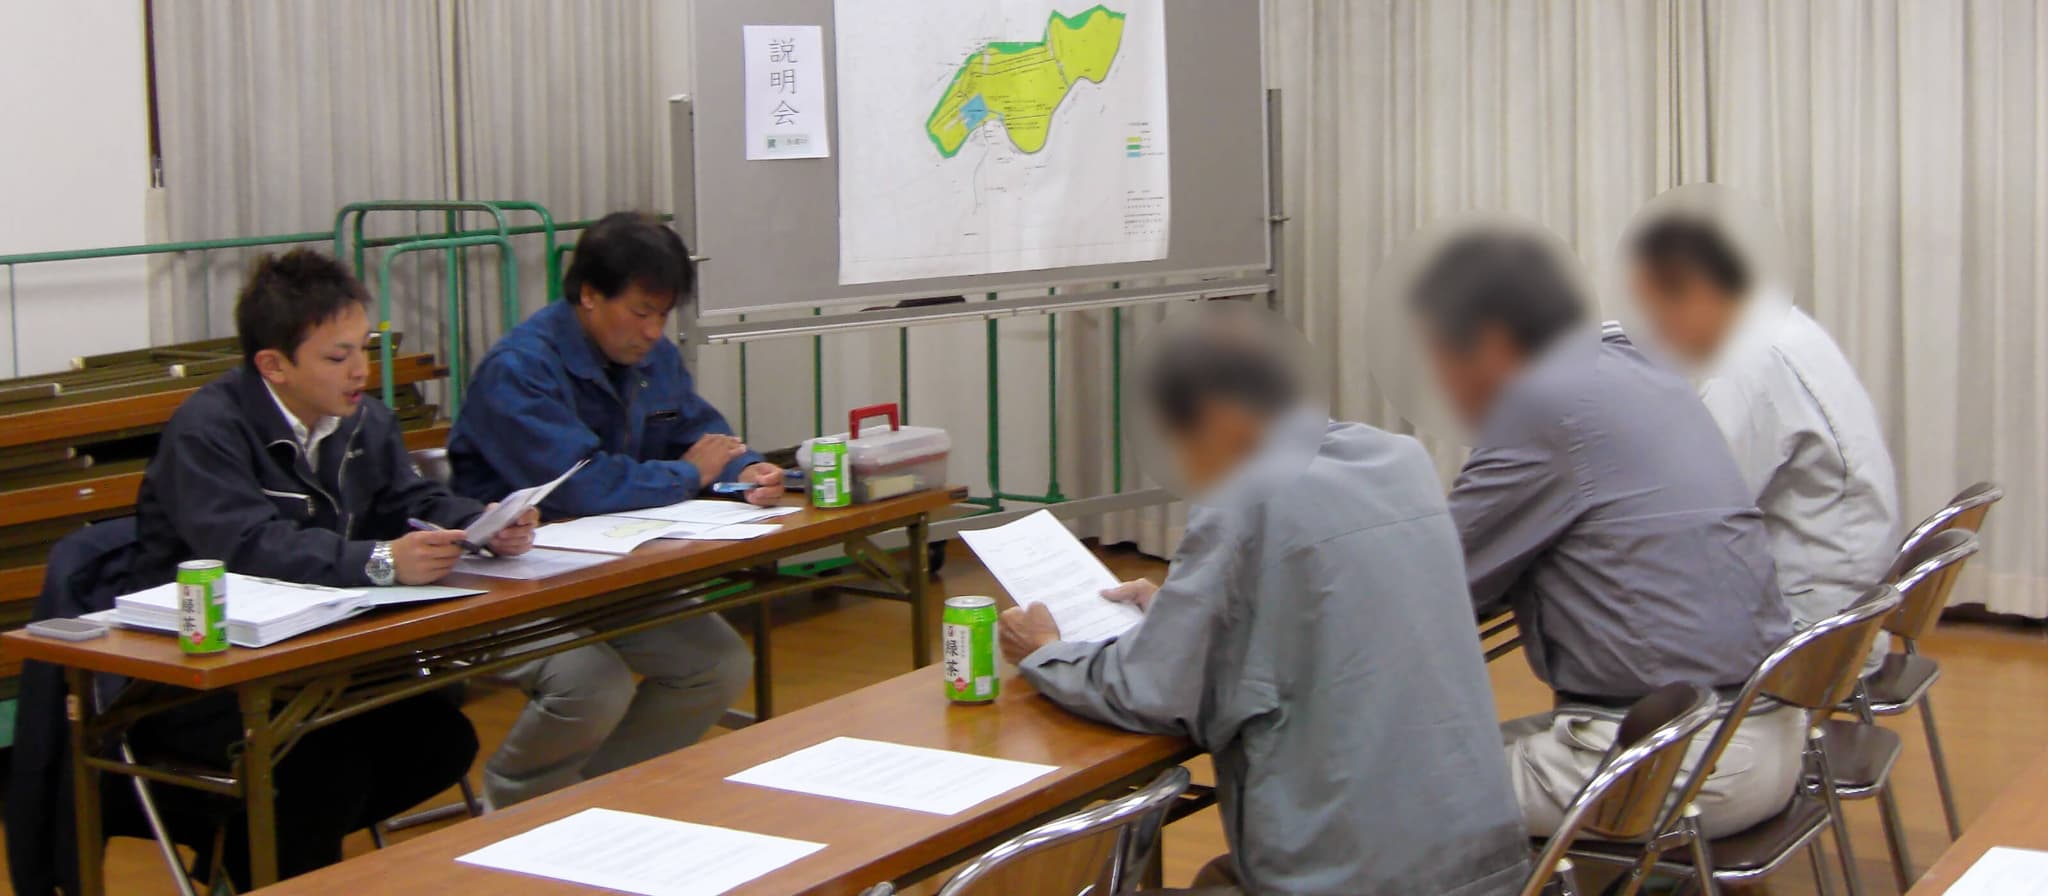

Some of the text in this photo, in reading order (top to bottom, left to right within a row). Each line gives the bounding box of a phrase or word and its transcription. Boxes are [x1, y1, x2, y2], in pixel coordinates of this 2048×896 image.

[767, 38, 800, 125] 説明会
[945, 639, 960, 678] 緑茶
